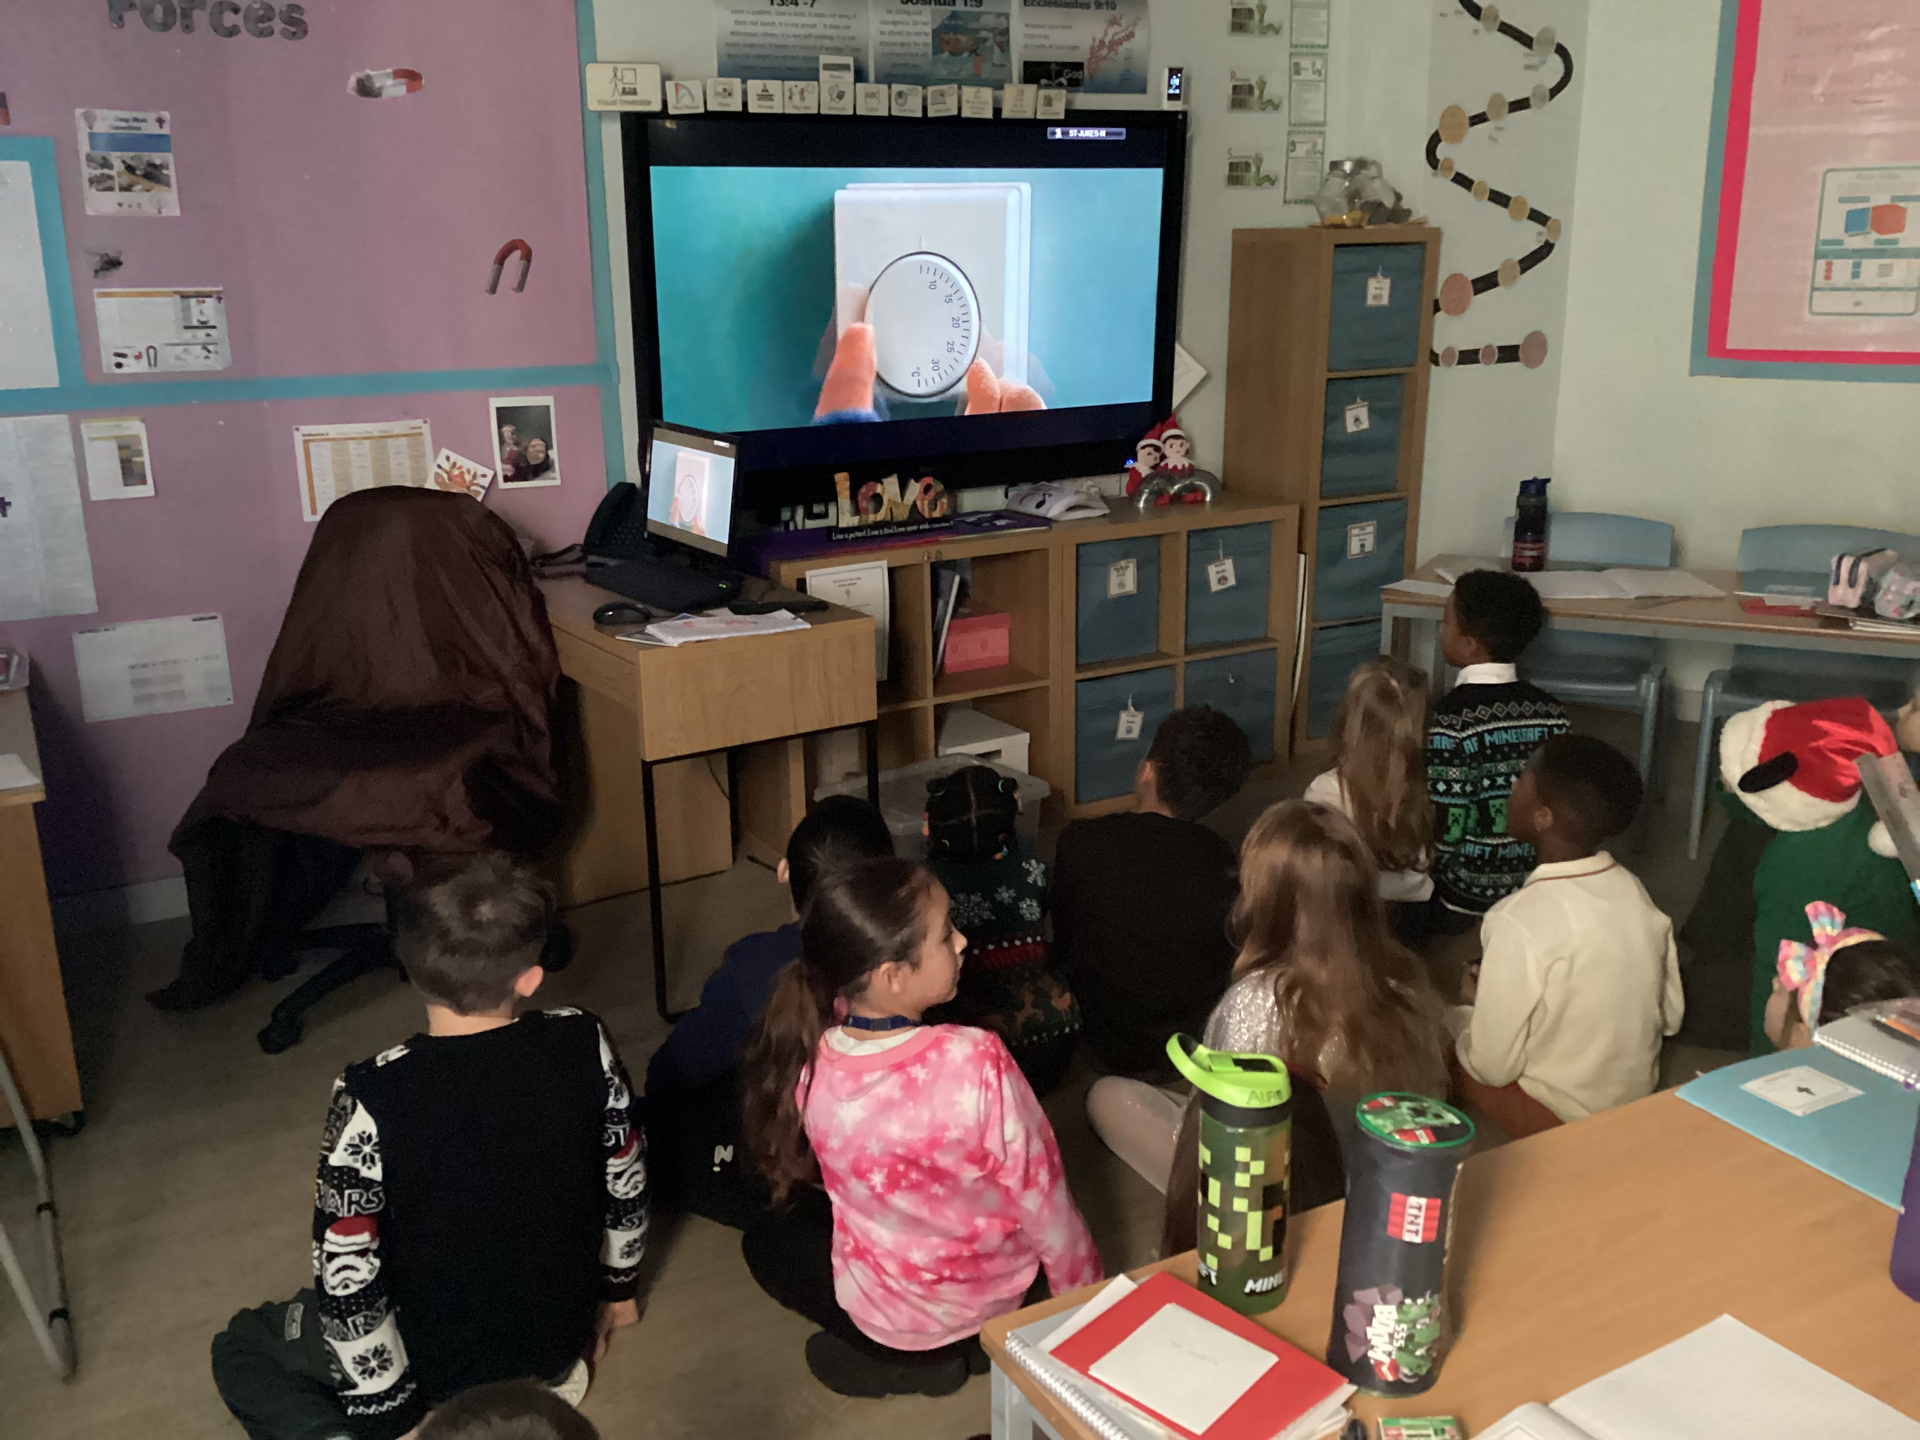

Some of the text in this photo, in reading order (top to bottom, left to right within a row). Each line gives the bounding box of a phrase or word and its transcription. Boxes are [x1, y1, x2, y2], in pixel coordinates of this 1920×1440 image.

[1023, 0, 1092, 10] Ecclesiastes
[108, 0, 309, 41] Forces
[1062, 68, 1084, 79] God
[928, 279, 938, 290] 10
[944, 293, 954, 304] 15
[951, 316, 961, 329] 20
[946, 340, 955, 353] 25
[931, 358, 940, 372] 30
[1484, 727, 1549, 747] MINECRAFT
[1405, 1203, 1423, 1237] TNT
